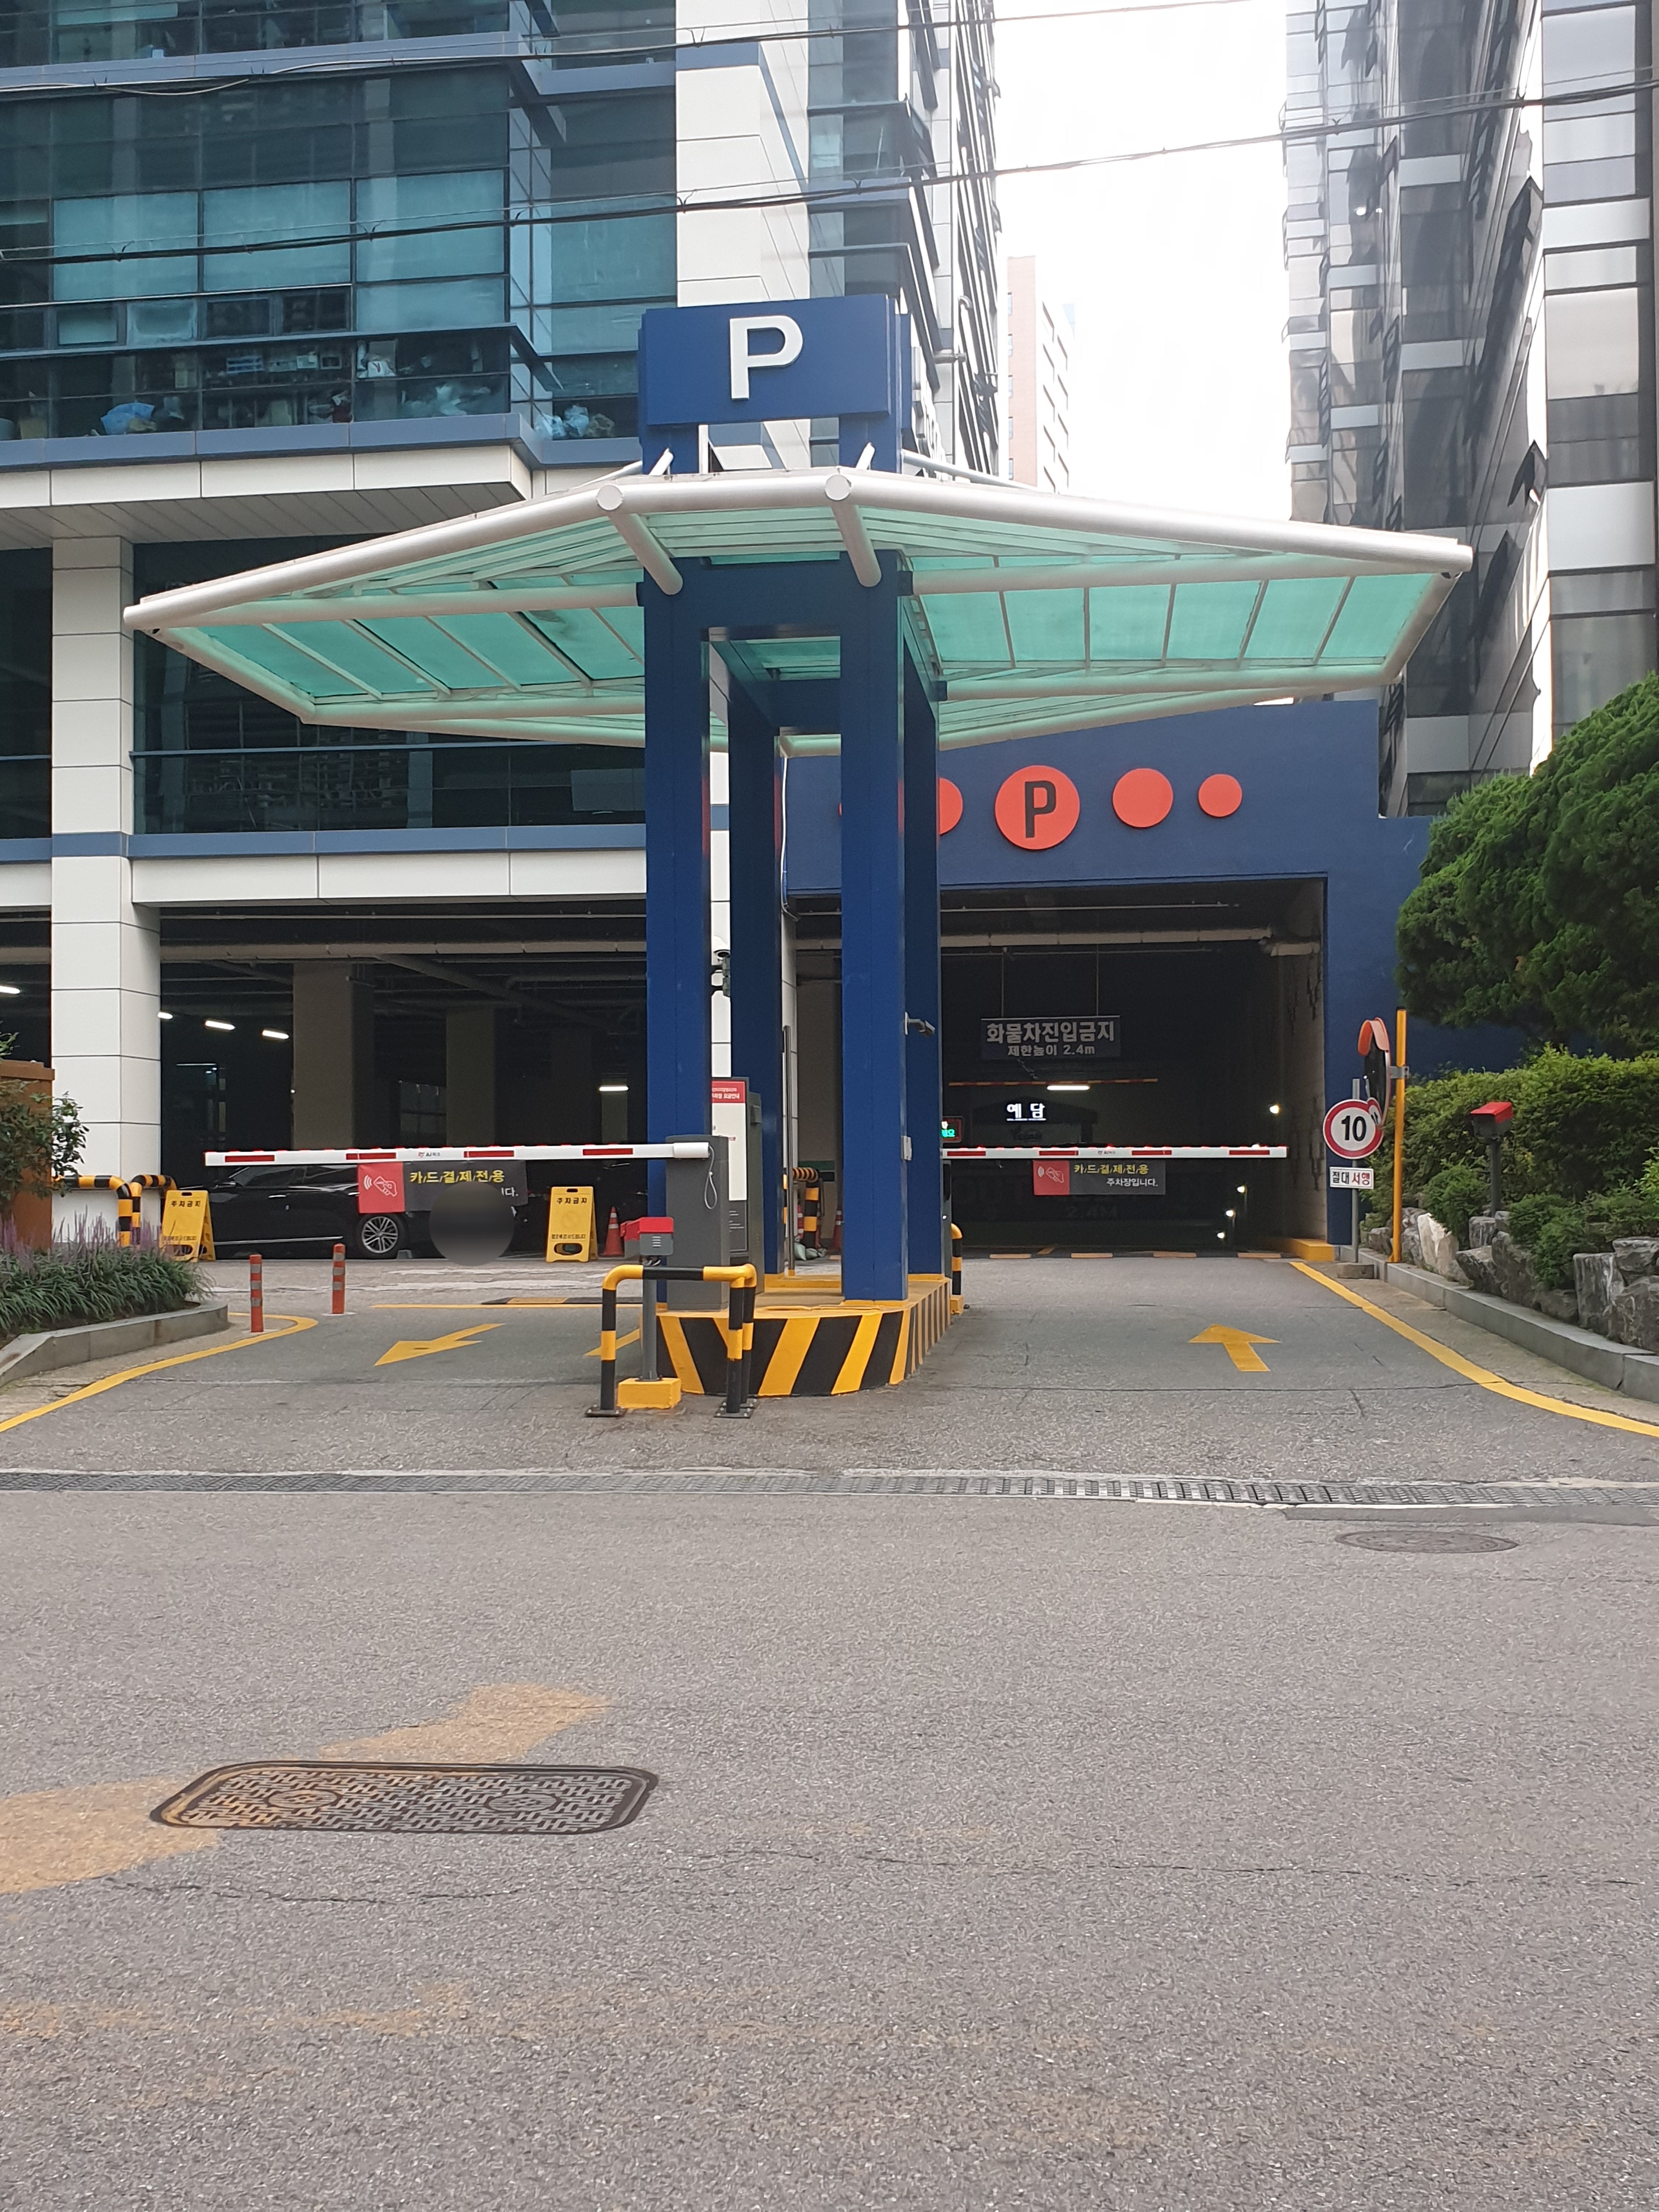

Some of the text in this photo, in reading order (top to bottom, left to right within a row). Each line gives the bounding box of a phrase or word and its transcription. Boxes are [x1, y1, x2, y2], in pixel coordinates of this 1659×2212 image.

[729, 315, 803, 400] P
[1024, 780, 1057, 838] P
[986, 1021, 1114, 1043] 화물차진입금지
[1007, 1044, 1095, 1057] 제한높이 2.4m
[1341, 1115, 1367, 1142] 10
